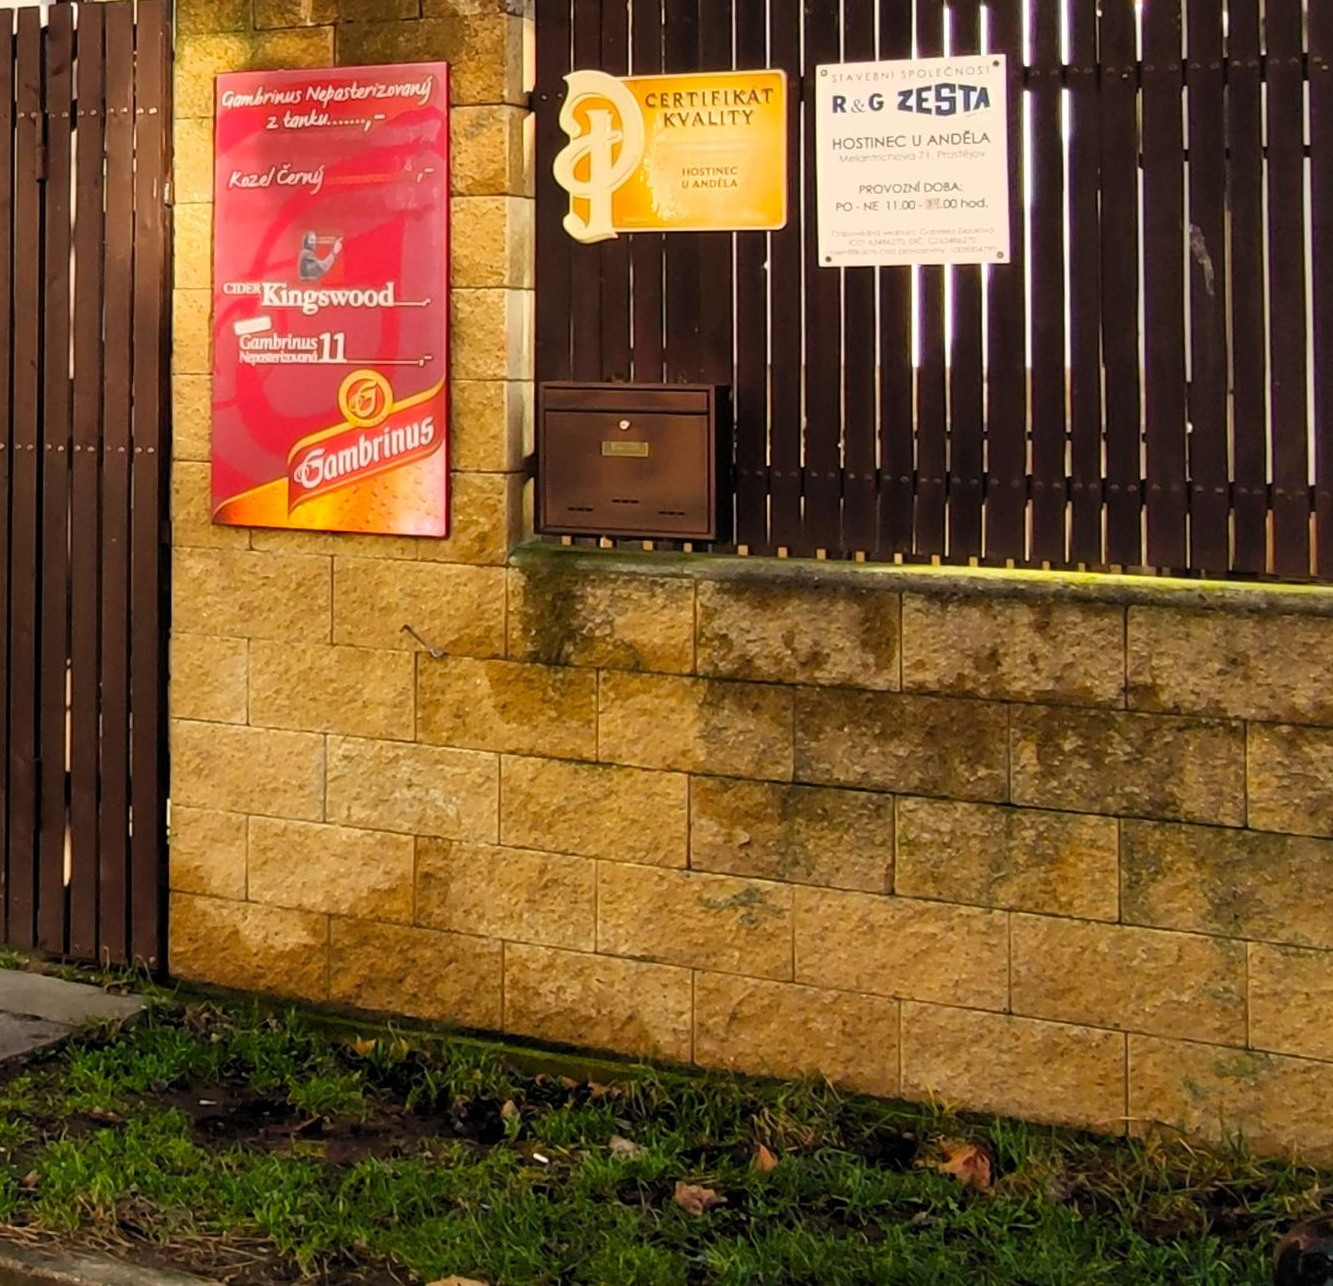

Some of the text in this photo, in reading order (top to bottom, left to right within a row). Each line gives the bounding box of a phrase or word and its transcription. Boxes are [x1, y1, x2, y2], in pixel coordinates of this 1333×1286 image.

[901, 65, 990, 80] SPOLEČNOST
[222, 75, 433, 109] Gambrinus Nepasterizovaný
[832, 82, 991, 116] R & G ZESTA
[664, 109, 754, 128] KVALITY
[832, 130, 992, 151] HOSTINEC U ANDĚLA
[228, 167, 276, 189] Kozel
[276, 163, 326, 196] Černý
[682, 167, 739, 177] HOSTINEC
[859, 181, 921, 195] PROVOZNÍ
[835, 201, 853, 212] PO
[863, 200, 880, 211] NE
[886, 200, 916, 212] 11.00
[960, 197, 989, 209] hod.
[222, 281, 395, 316] CIDER Kingswood
[239, 332, 318, 350] Gambrinus
[318, 331, 348, 364] 11
[294, 416, 435, 490] Gambrinus
